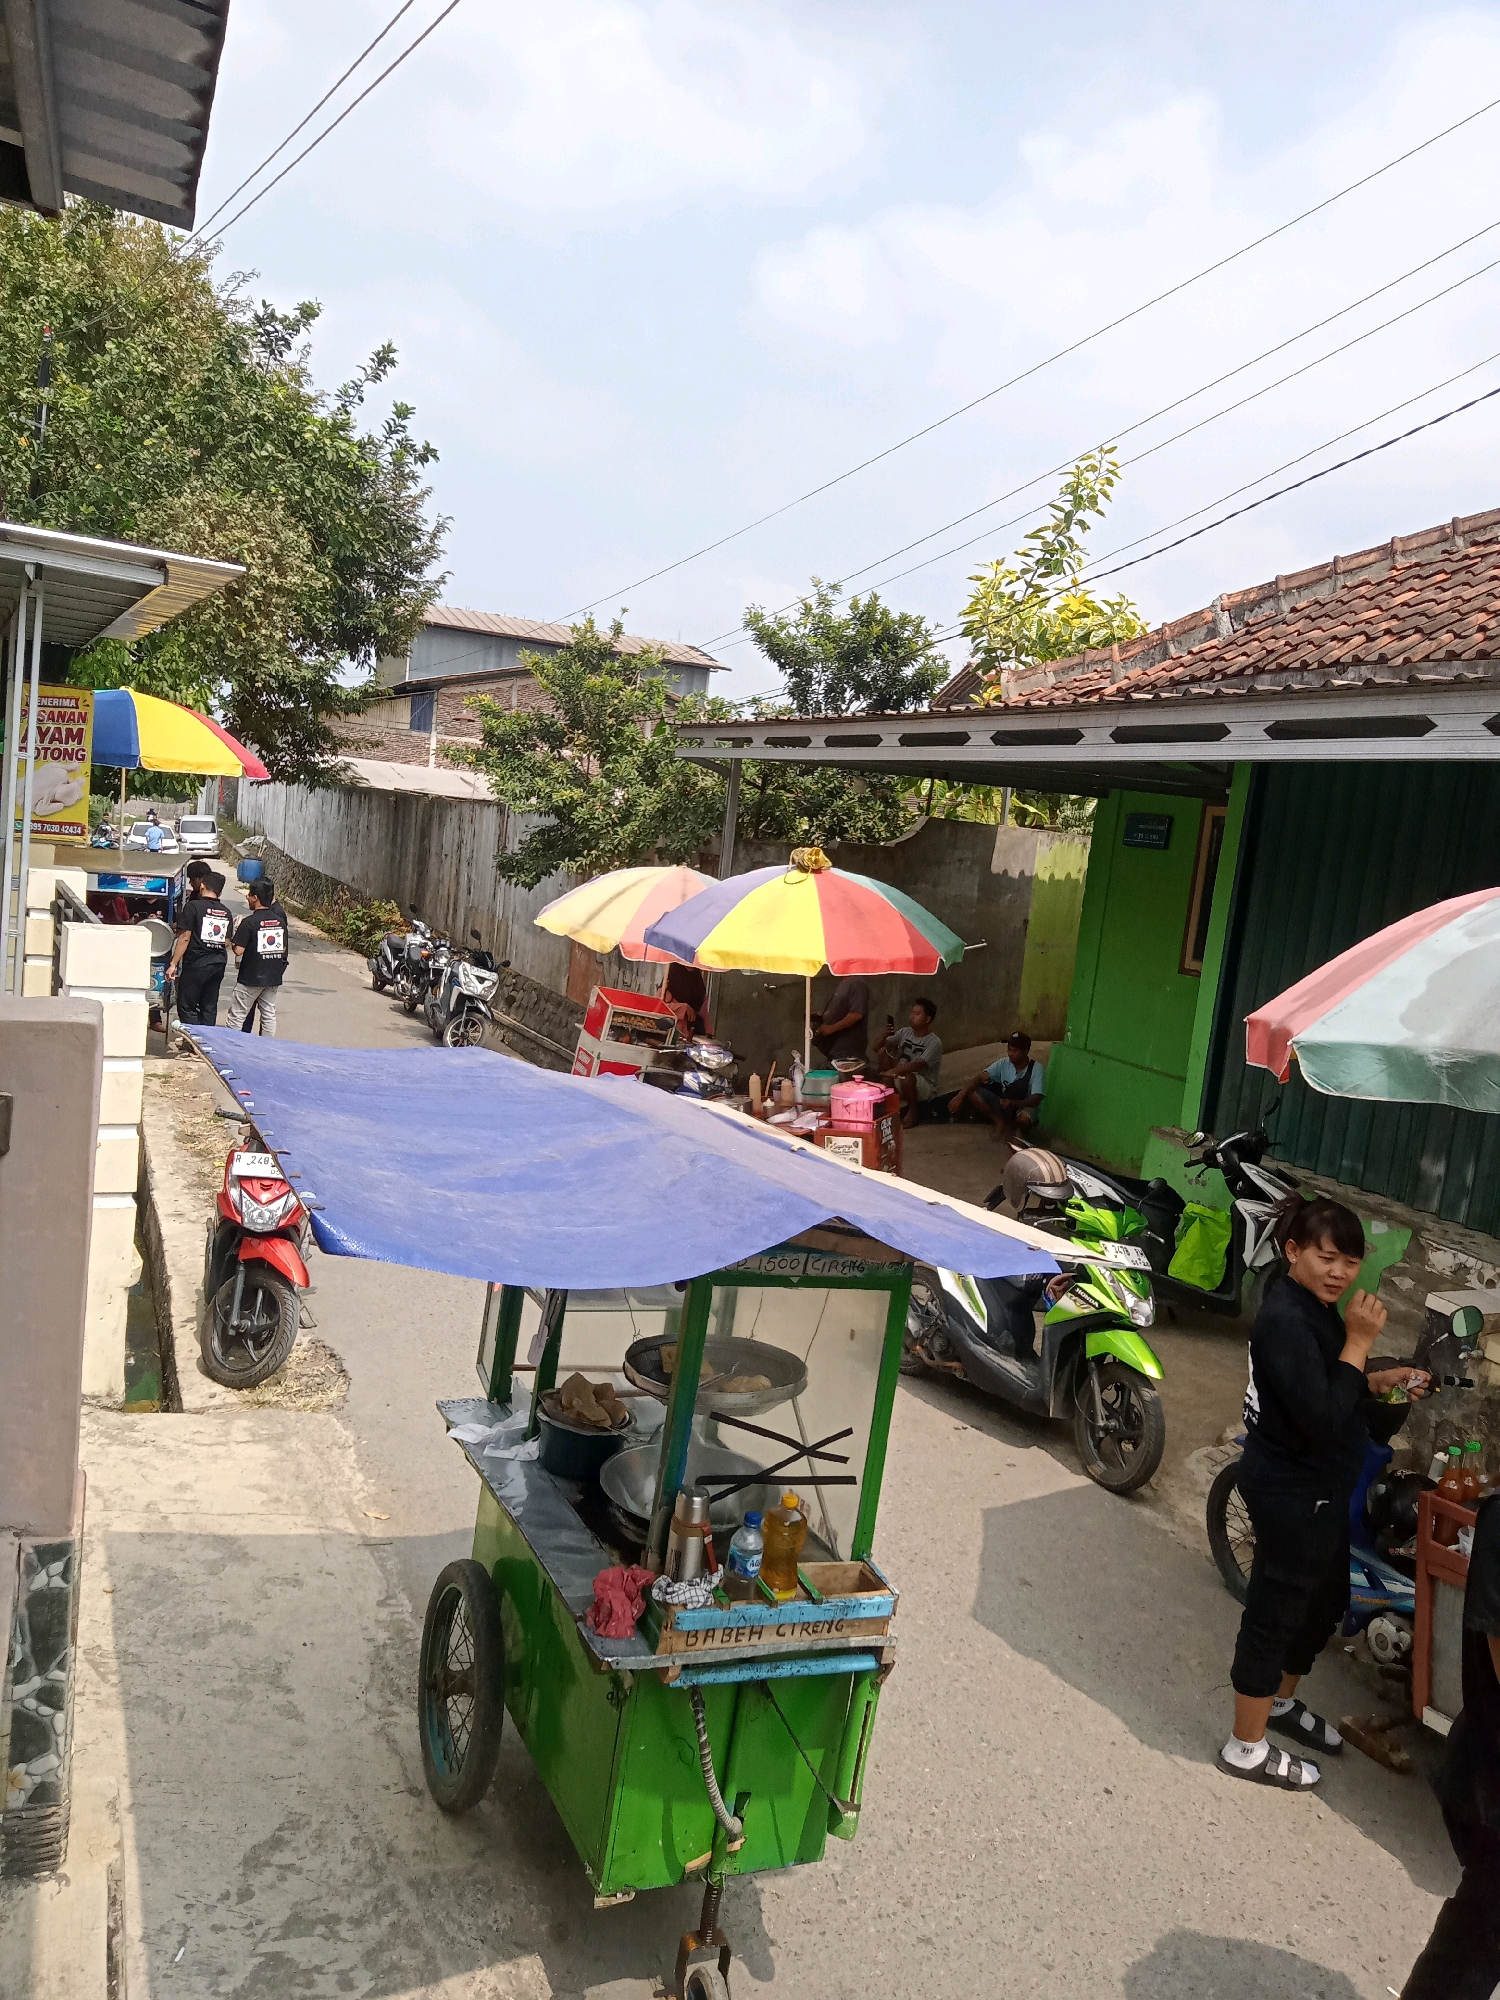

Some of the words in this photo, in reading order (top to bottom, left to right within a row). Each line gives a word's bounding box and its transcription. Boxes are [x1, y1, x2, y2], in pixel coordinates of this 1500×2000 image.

[28, 696, 76, 708] ENERIMA
[21, 709, 88, 723] PSANAN
[1075, 1287, 1099, 1308] HONDA
[685, 1624, 764, 1647] BABEH
[775, 1618, 844, 1639] CIRENG
